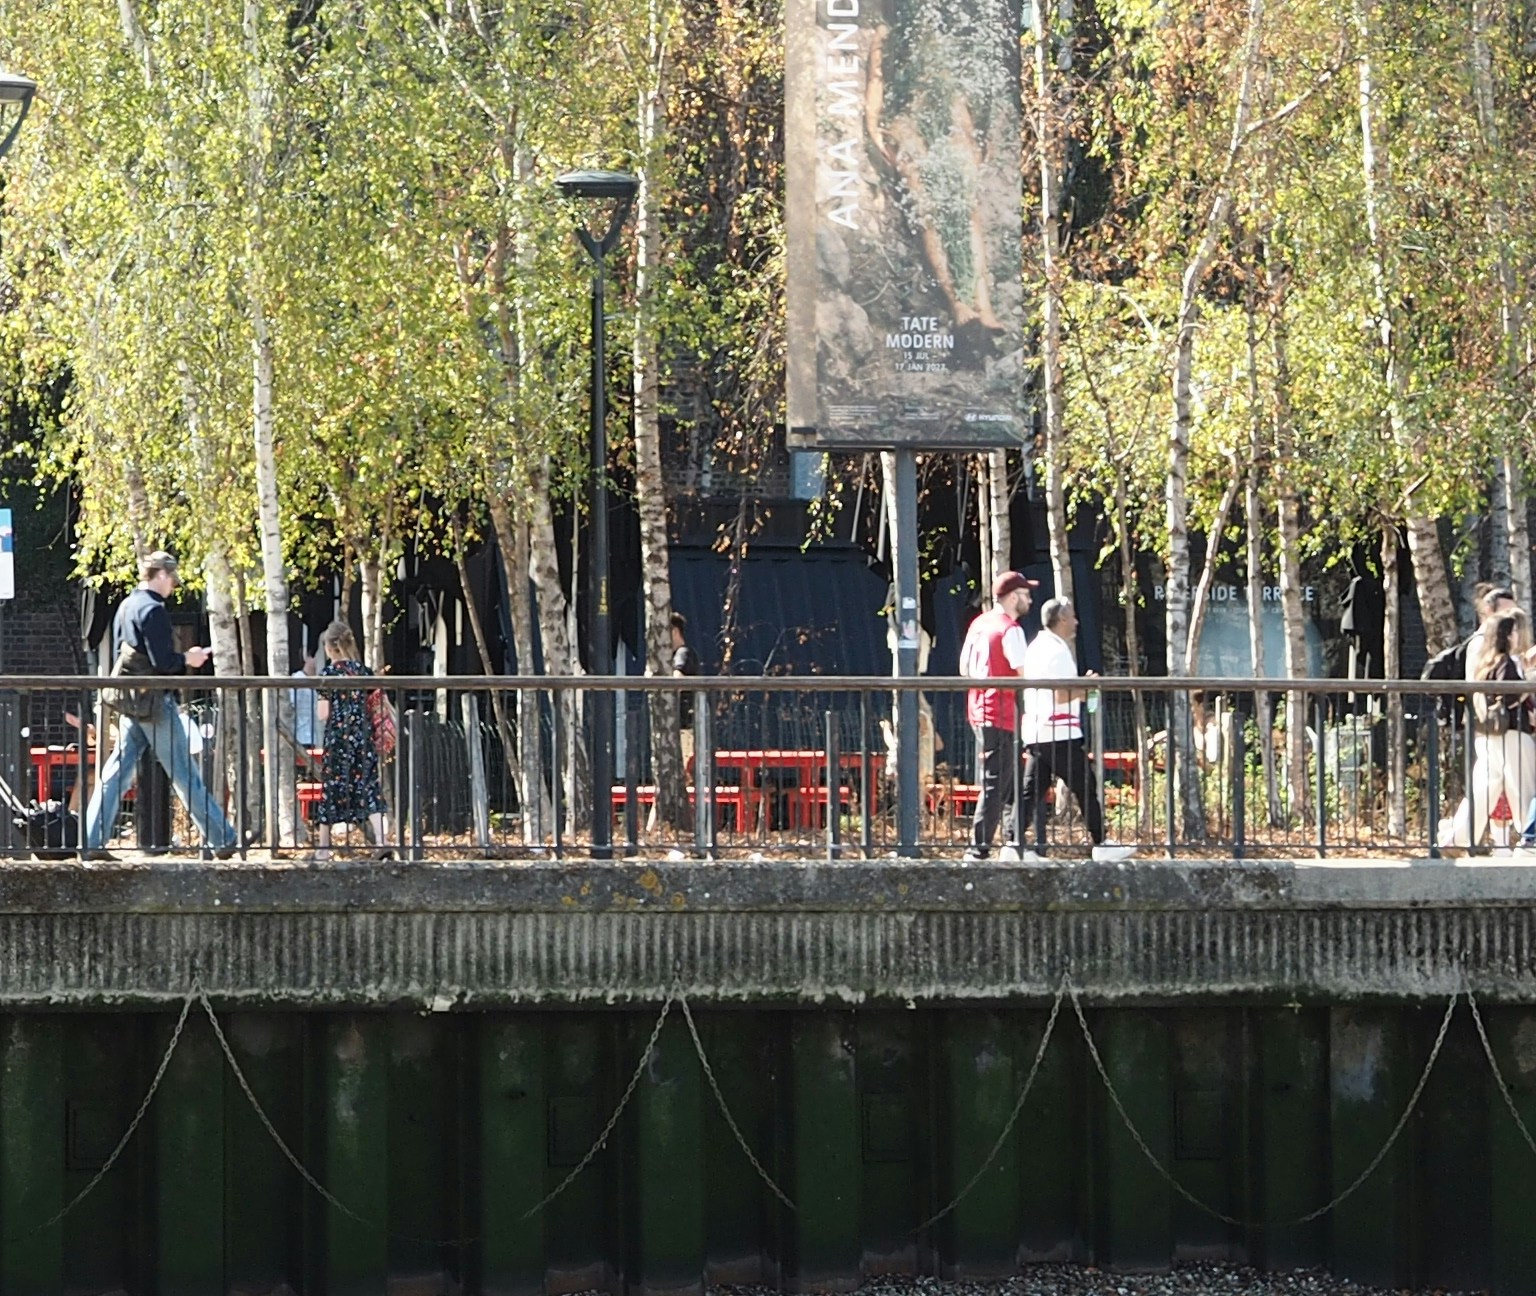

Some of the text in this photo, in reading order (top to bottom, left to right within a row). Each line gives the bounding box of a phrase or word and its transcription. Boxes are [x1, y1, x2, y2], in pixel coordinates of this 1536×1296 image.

[828, 138, 860, 230] ANA
[901, 316, 938, 331] TATE
[886, 334, 954, 349] MODERN
[908, 363, 923, 372] JAN
